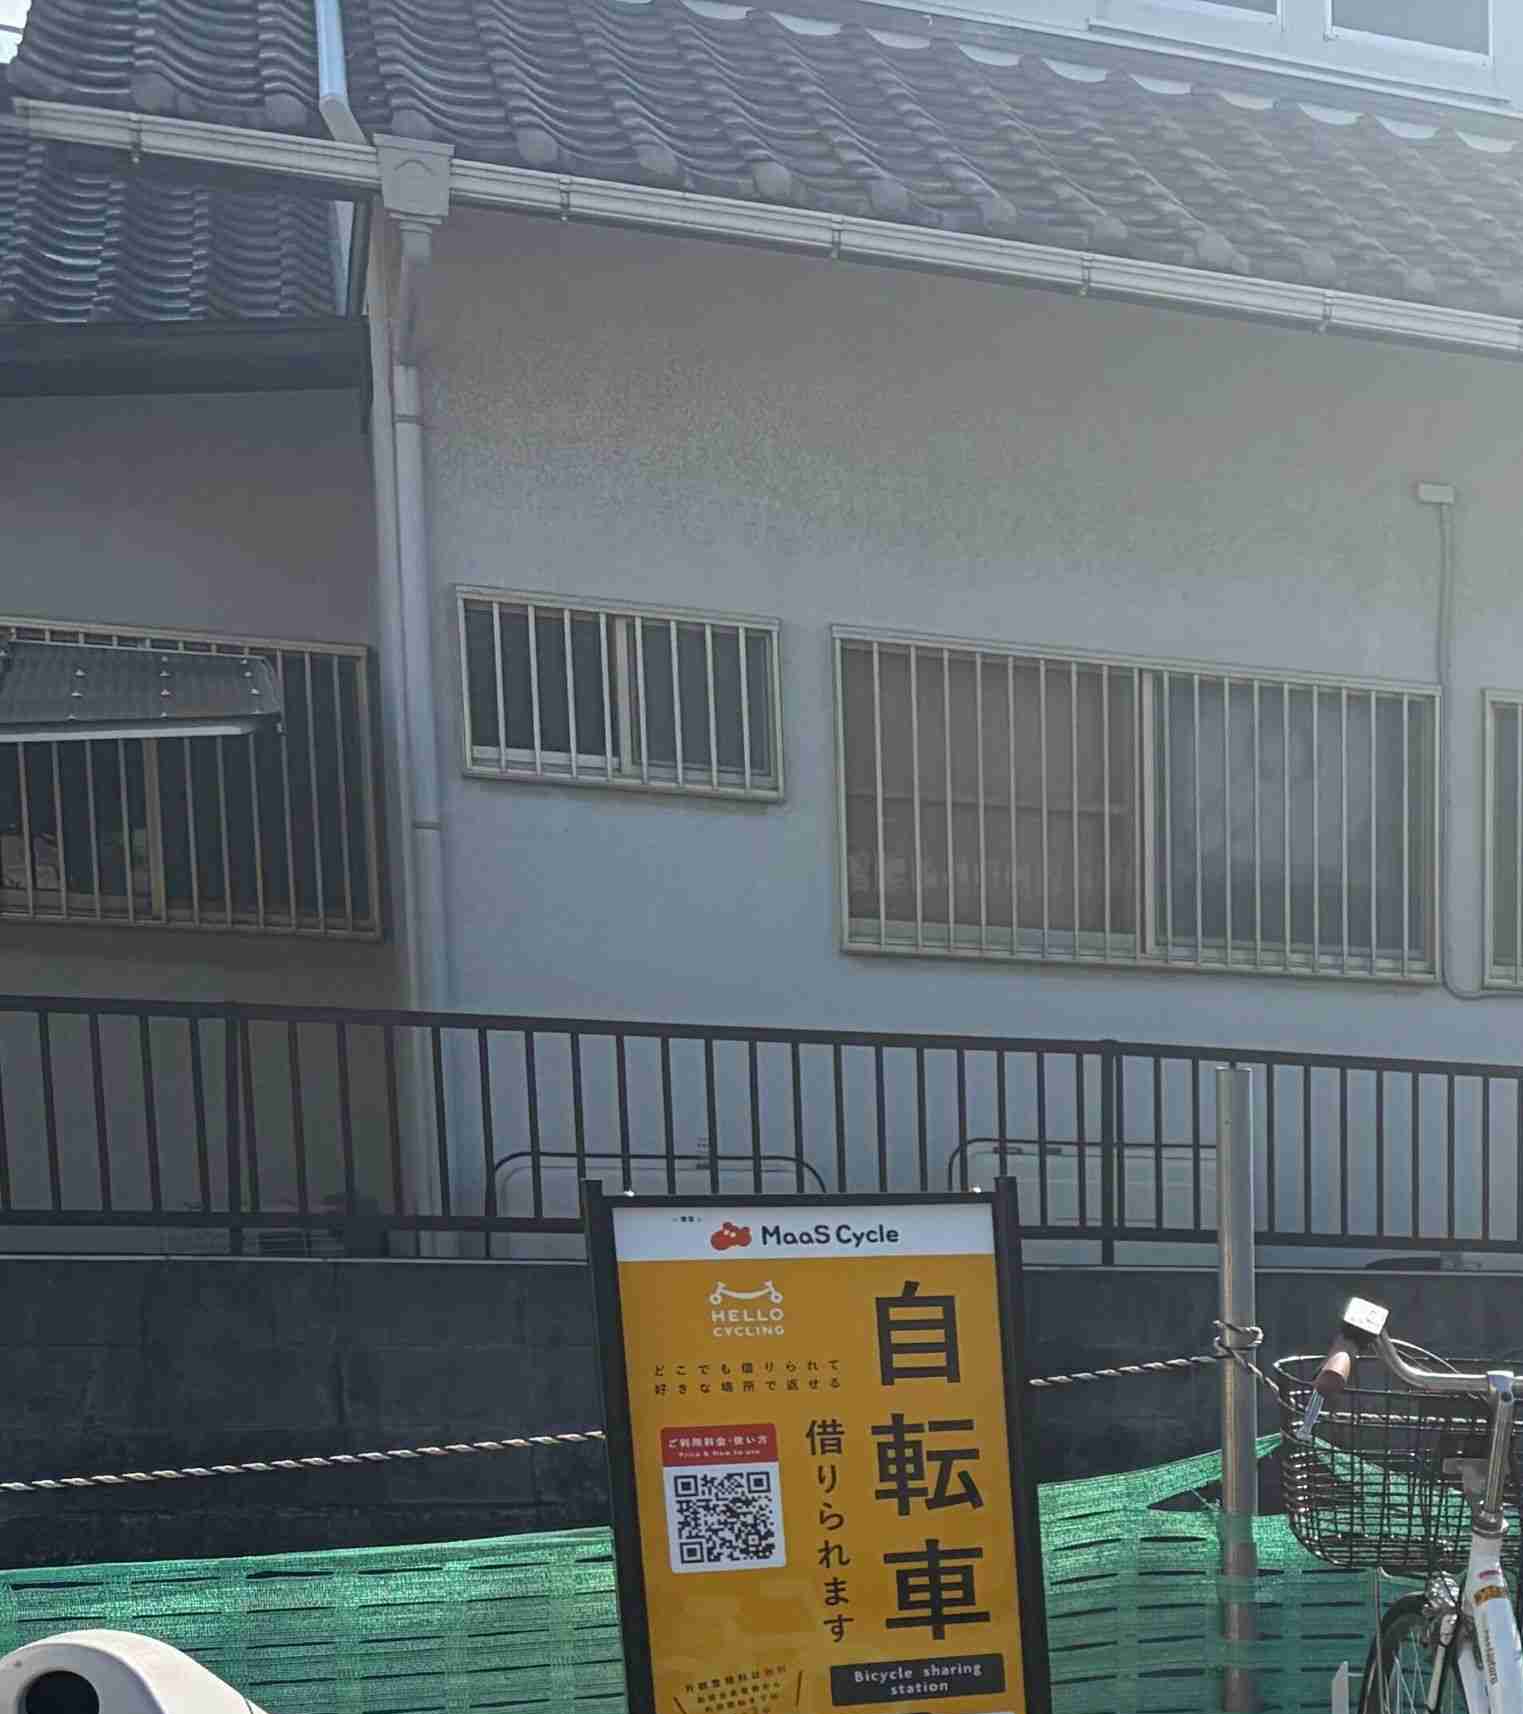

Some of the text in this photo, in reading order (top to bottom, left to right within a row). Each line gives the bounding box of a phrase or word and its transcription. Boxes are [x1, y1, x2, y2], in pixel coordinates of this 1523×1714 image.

[761, 1223, 900, 1248] MaaS Cycle
[711, 1308, 785, 1322] HELLO
[713, 1326, 785, 1338] CYCLING
[870, 1280, 991, 1641] 自転車
[805, 1418, 855, 1643] 借りられます
[854, 1661, 983, 1684] Bicycle sharing
[889, 1680, 949, 1697] station
